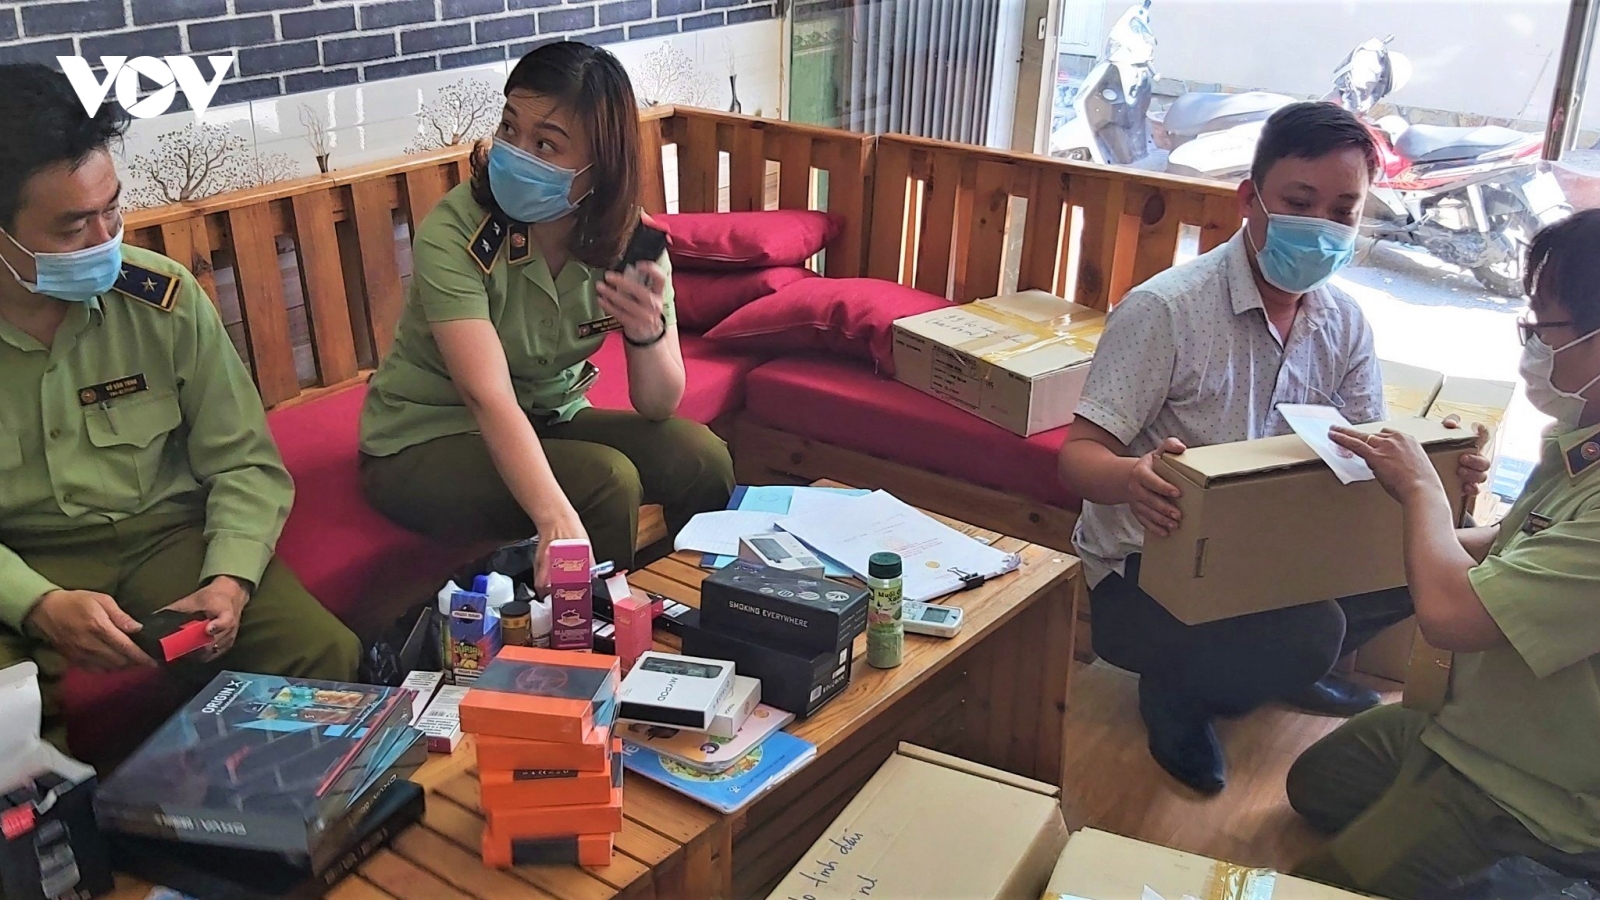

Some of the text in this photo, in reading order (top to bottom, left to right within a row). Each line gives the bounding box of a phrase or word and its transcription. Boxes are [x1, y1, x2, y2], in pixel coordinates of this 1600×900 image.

[728, 601, 809, 628] SMOKING EVERYWHERE
[201, 684, 234, 714] ORIGIN
[657, 676, 679, 702] MYPOD
